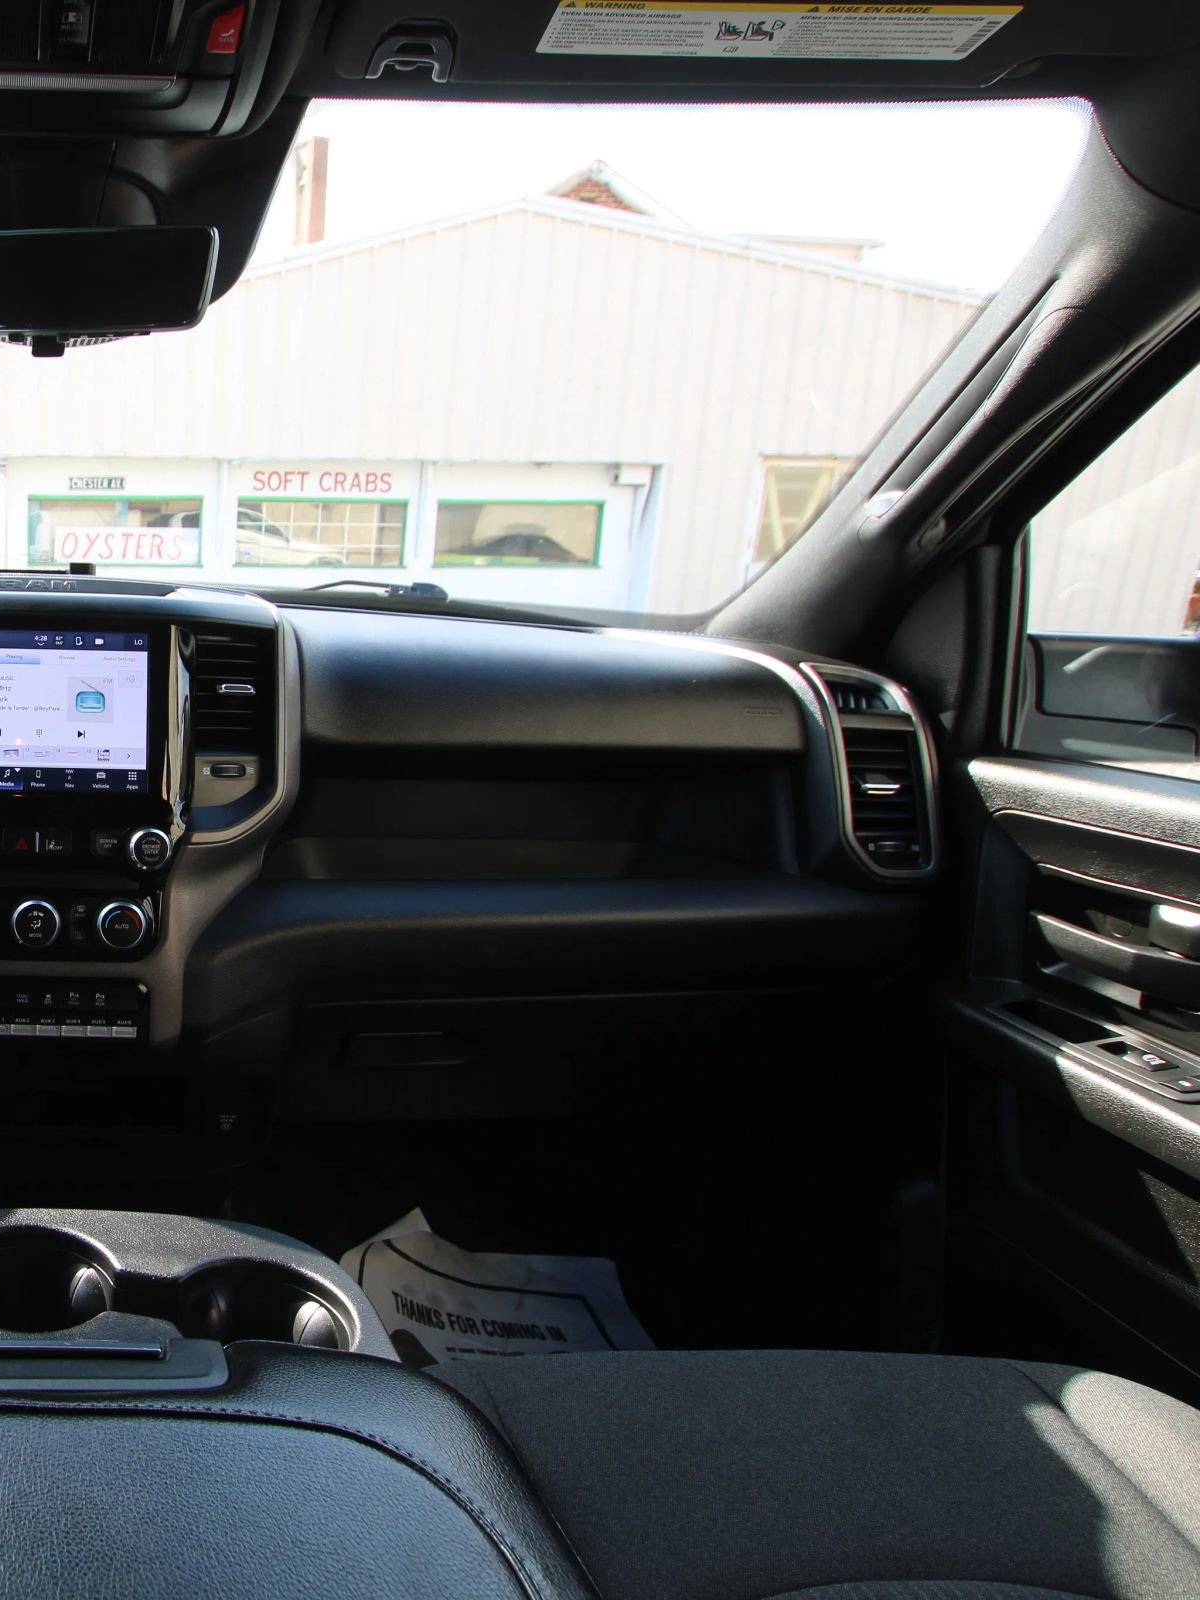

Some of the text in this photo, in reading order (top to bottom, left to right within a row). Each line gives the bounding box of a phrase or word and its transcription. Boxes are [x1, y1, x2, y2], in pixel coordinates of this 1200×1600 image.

[72, 478, 108, 489] CHESTER
[253, 471, 392, 493] SOFT CRABS
[61, 531, 183, 560] OYSTERS
[392, 1291, 568, 1342] THANKS FOR COMING IN
